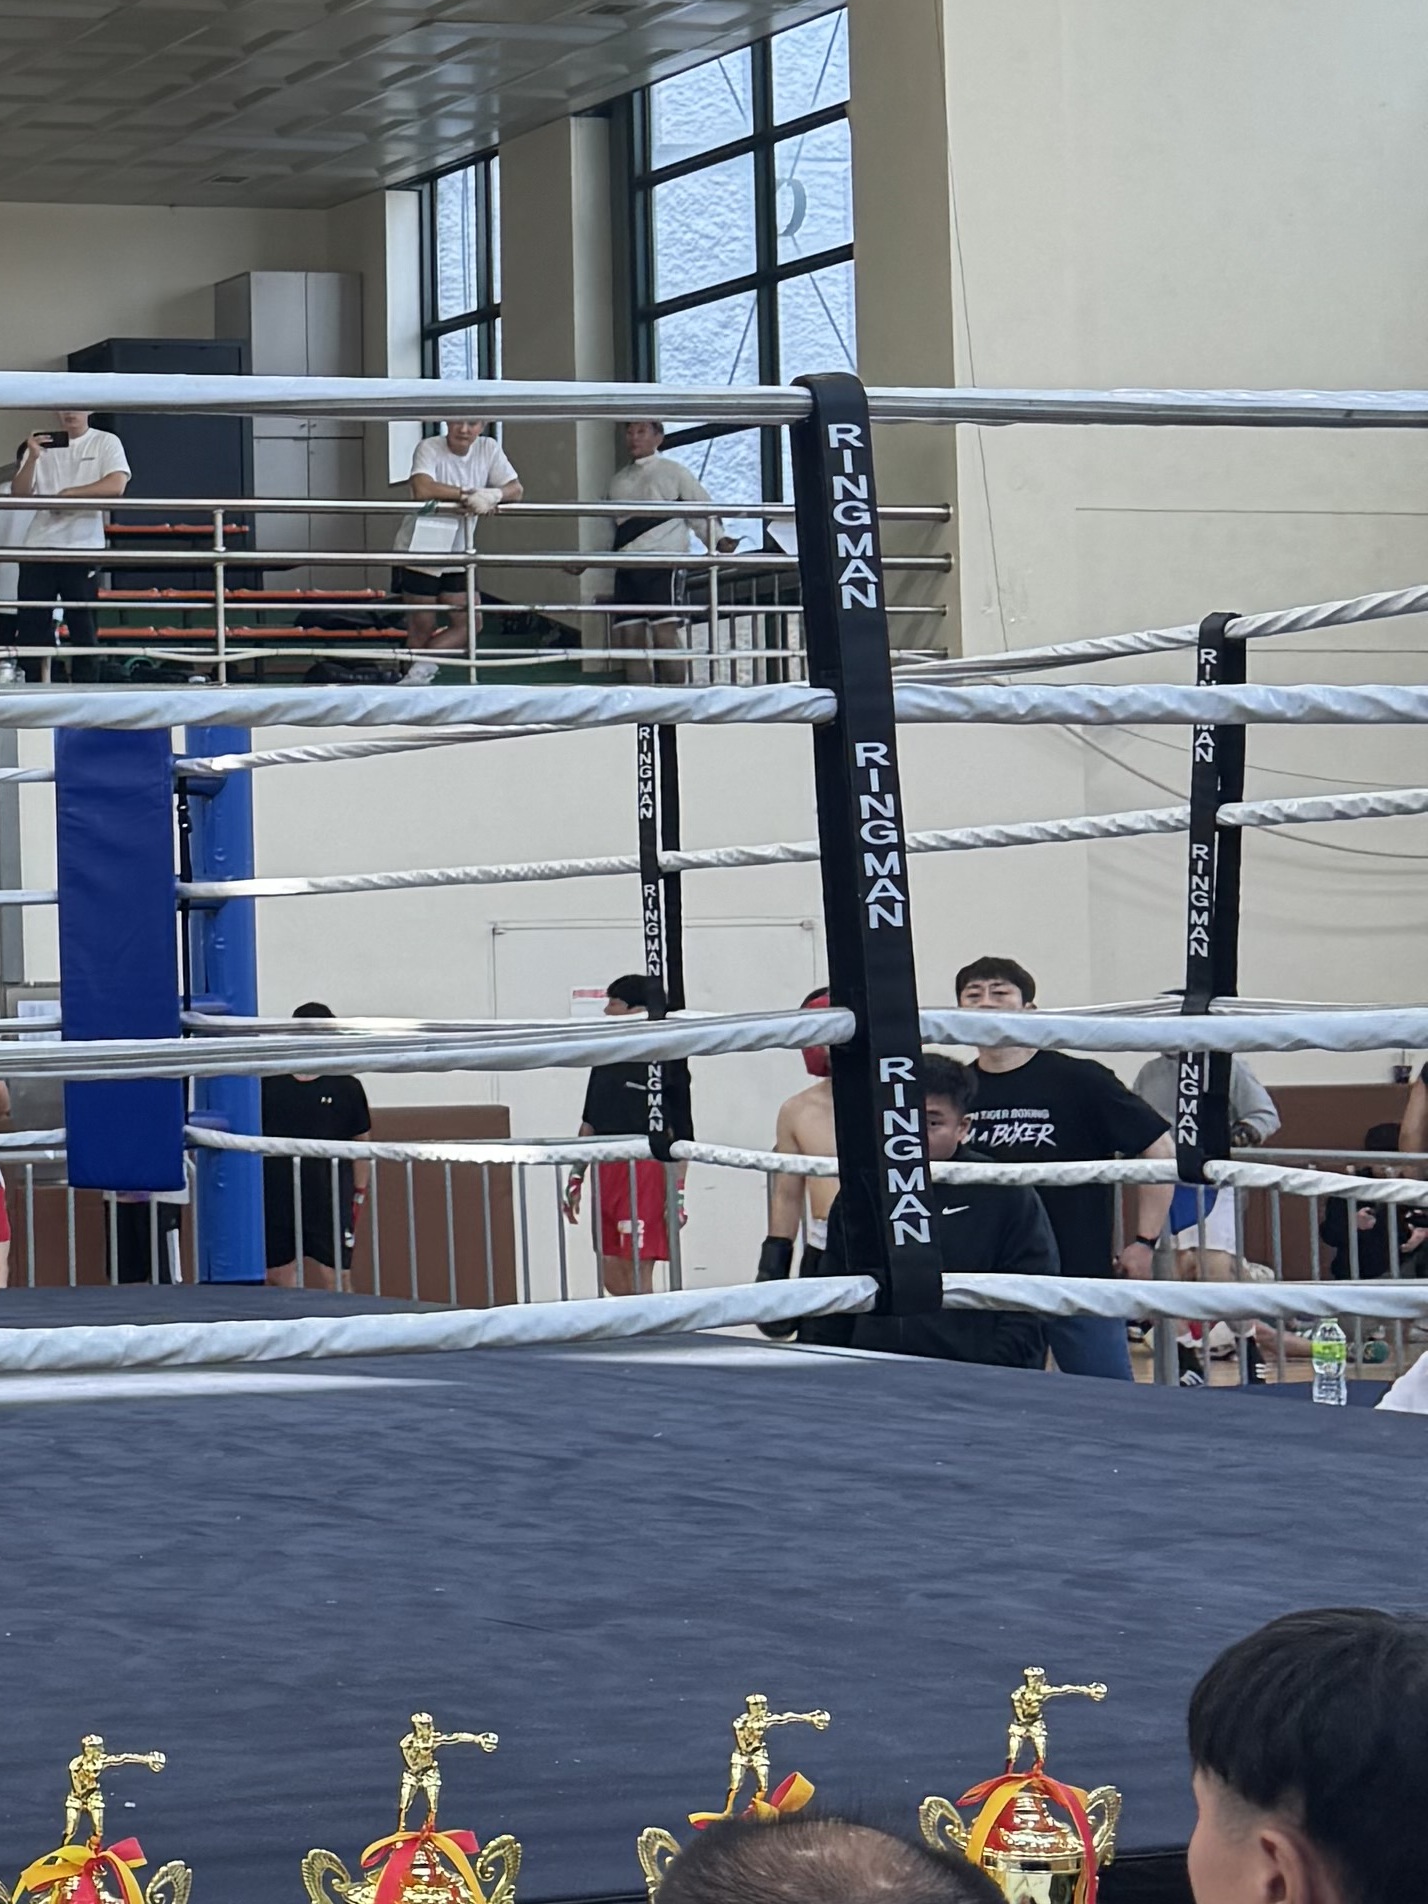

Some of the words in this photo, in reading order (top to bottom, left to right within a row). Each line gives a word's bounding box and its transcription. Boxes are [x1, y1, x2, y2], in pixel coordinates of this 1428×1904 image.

[827, 423, 879, 610] RINGMAN
[638, 727, 654, 819] RINGMAN
[854, 742, 906, 929] RINGMAN
[644, 884, 662, 977] RINGMAN
[1189, 844, 1210, 958] RINGMAN
[647, 1062, 664, 1132] NGMAN
[989, 1121, 1057, 1147] BOXER
[1177, 1051, 1199, 1147] INGMAN
[879, 1056, 932, 1246] RINGMAN
